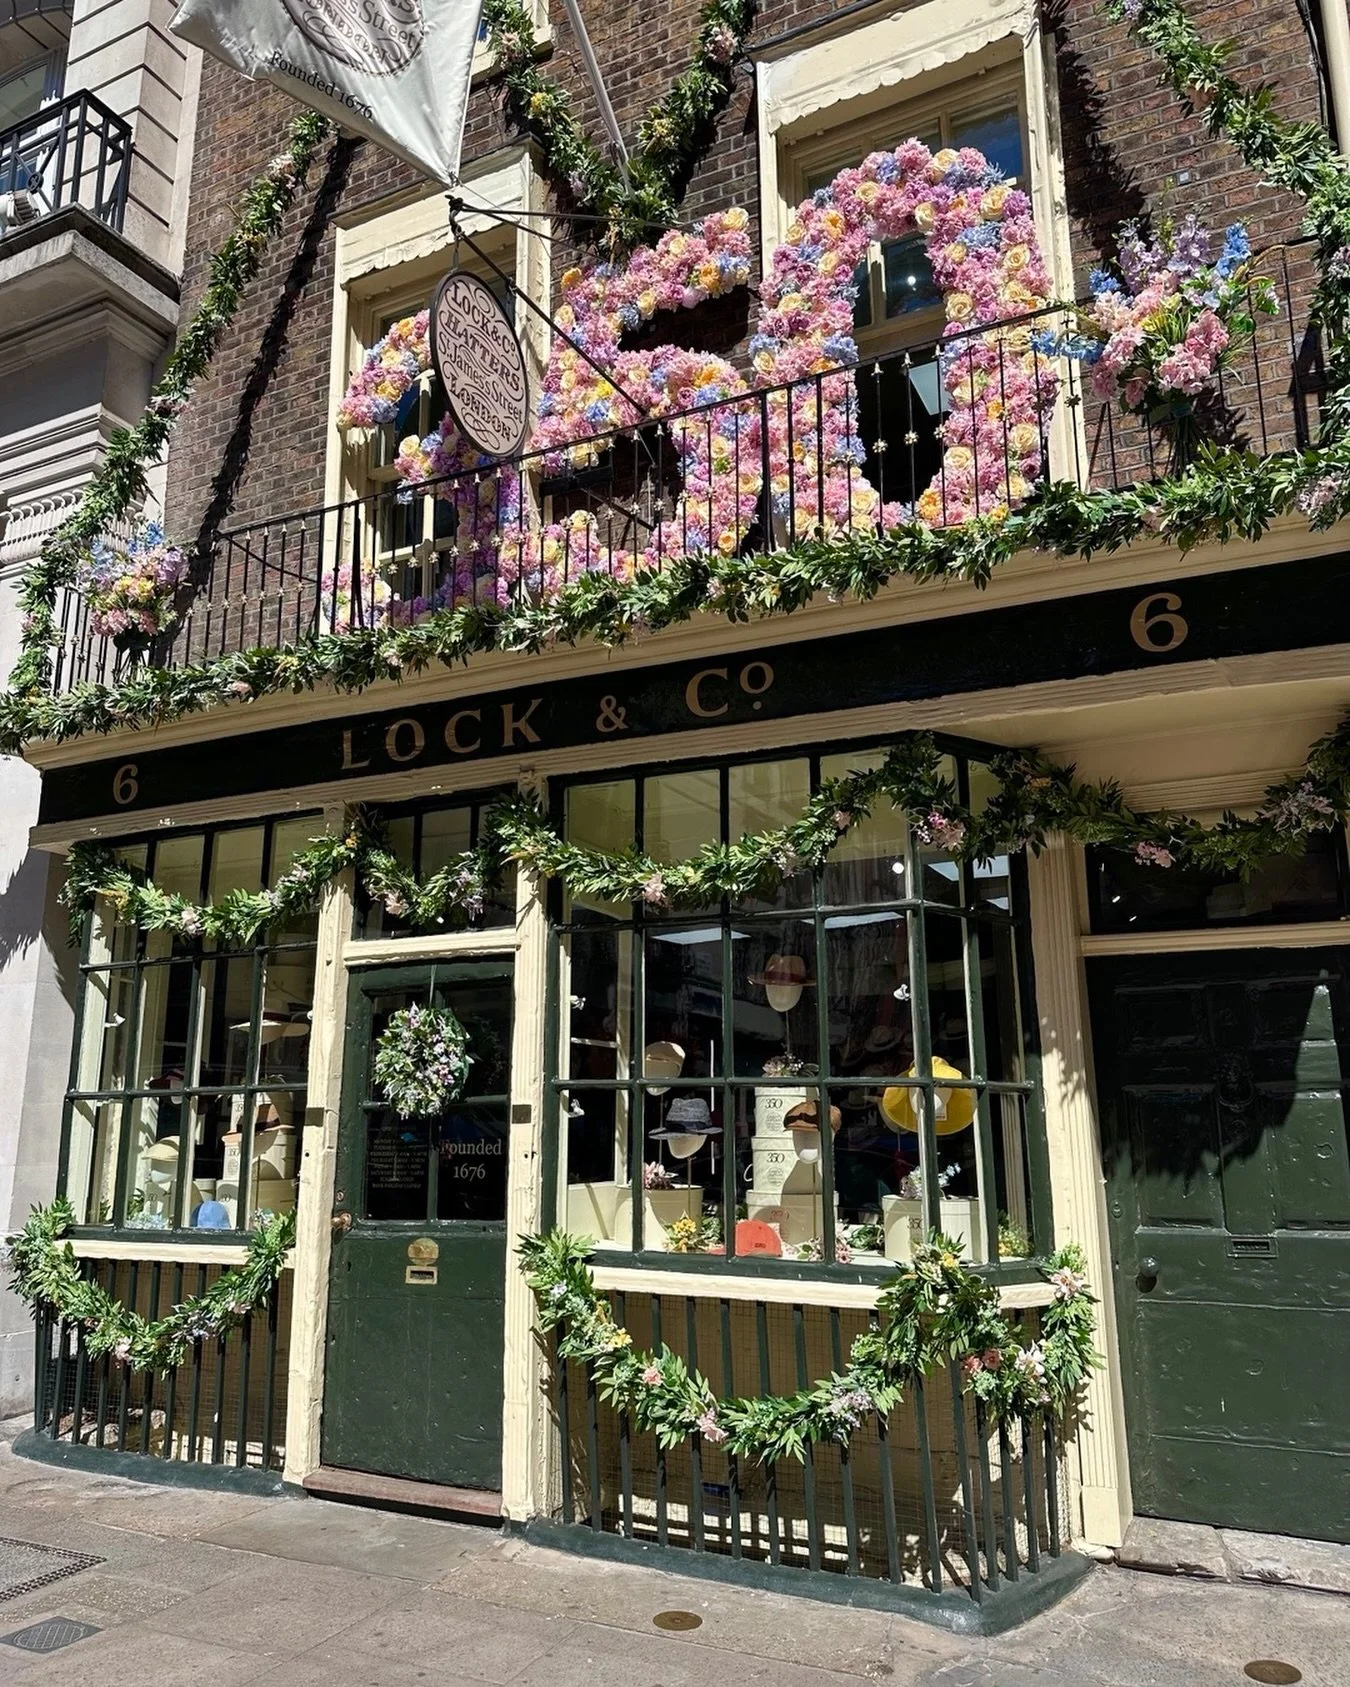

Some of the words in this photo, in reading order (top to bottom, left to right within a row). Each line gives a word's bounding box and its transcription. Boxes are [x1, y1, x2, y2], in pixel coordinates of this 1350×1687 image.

[359, 0, 416, 48] Street
[269, 51, 337, 97] Founded
[338, 92, 374, 120] 1676
[445, 310, 520, 391] HATTERS
[449, 373, 512, 442] LONDON
[491, 379, 523, 423] Street
[1130, 592, 1188, 652] 6
[340, 698, 542, 771] LOCK
[595, 695, 628, 733] &
[112, 763, 139, 805] 6
[440, 1138, 502, 1155] Founded
[453, 1162, 486, 1182] 1676
